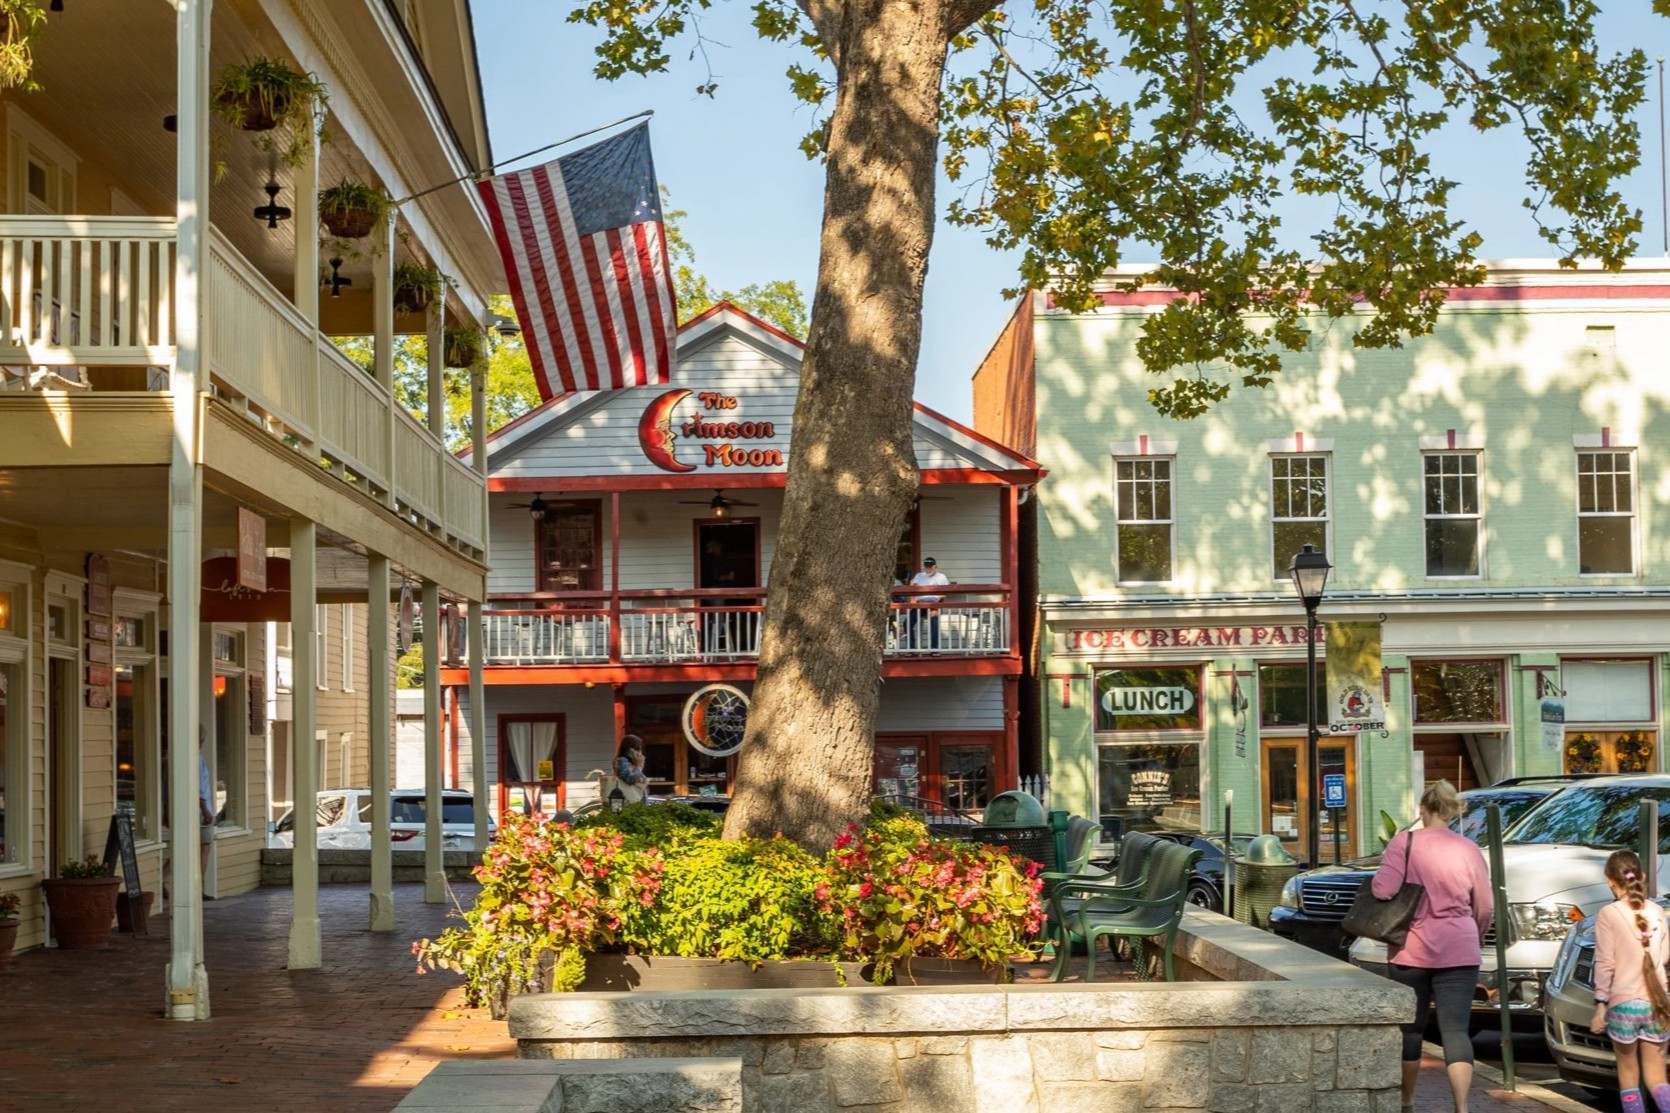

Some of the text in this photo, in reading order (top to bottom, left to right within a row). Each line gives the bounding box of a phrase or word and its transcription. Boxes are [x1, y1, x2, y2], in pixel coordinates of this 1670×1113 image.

[699, 392, 737, 409] The
[703, 444, 783, 467] Moon
[1073, 629, 1124, 649] ICE
[1131, 628, 1241, 648] CREAM
[1111, 691, 1185, 711] LUNCH
[1330, 721, 1385, 732] OCTOBER
